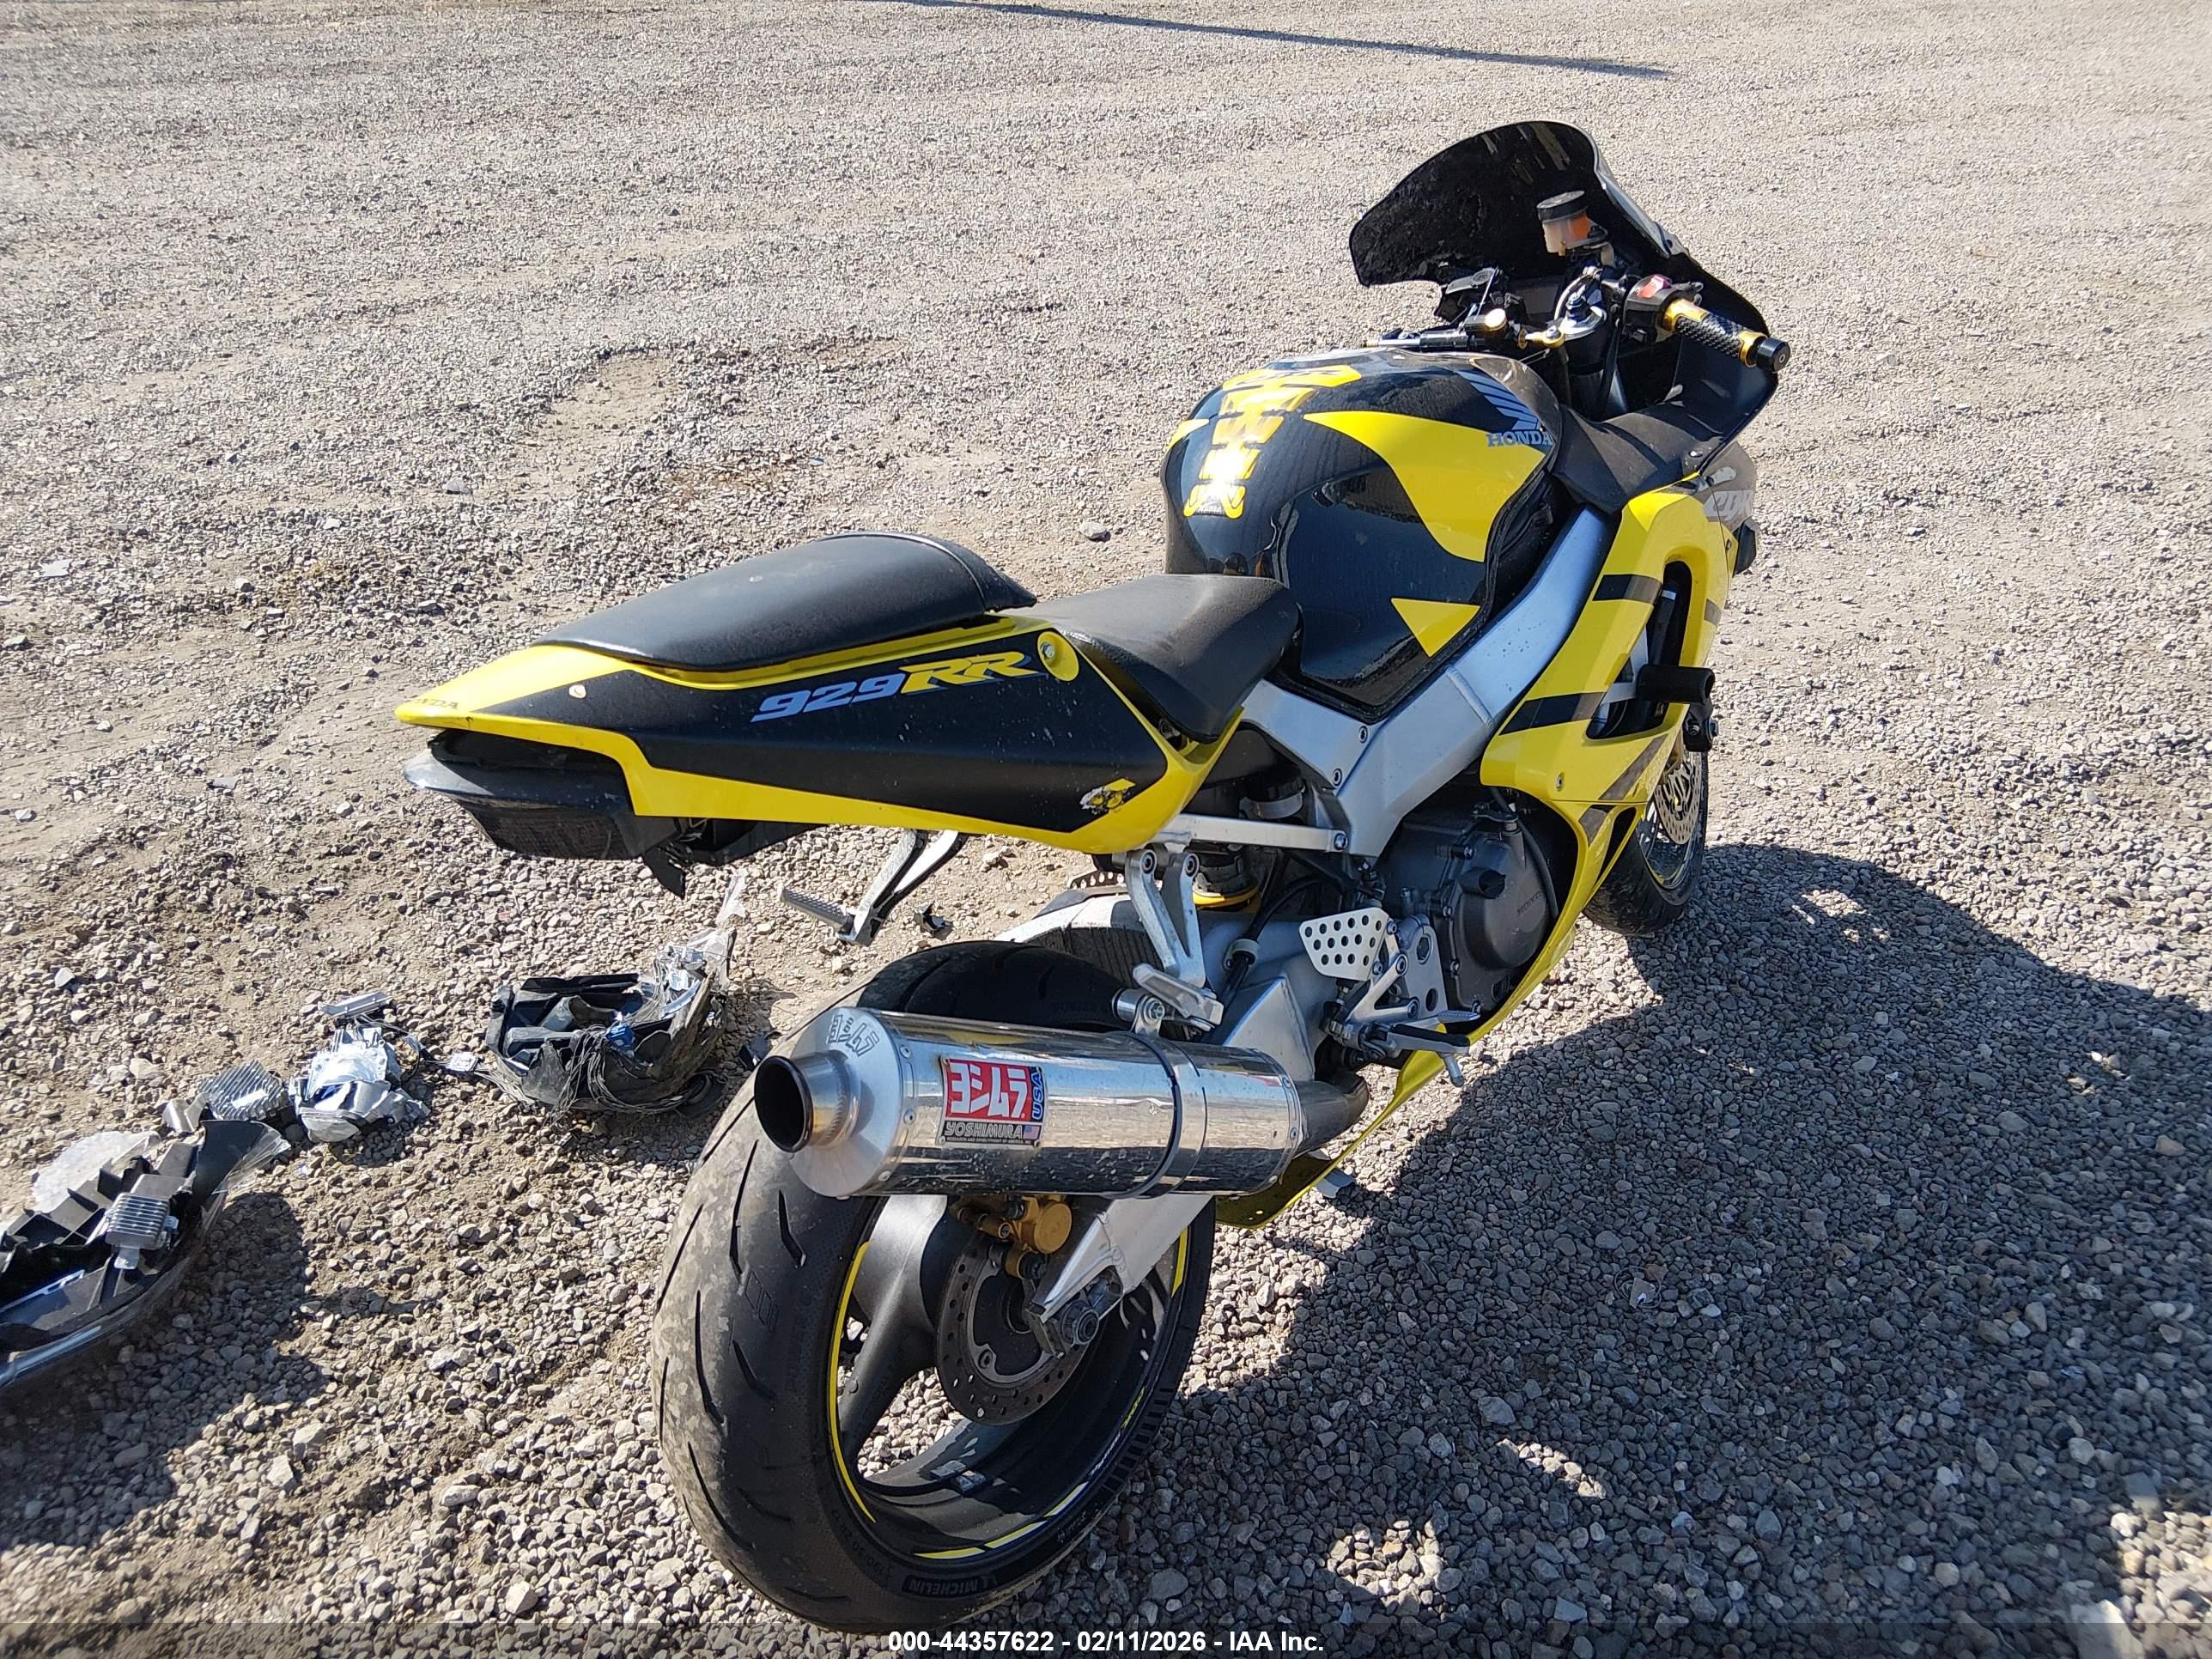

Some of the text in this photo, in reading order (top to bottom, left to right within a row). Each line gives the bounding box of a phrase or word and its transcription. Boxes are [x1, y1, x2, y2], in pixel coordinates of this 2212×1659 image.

[1486, 430, 1553, 448] HONDA
[750, 651, 1048, 723] 929RR
[1516, 890, 1542, 917] HOND
[1030, 1070, 1045, 1121] USA
[945, 1121, 1023, 1139] YOSHIMURA
[908, 1577, 979, 1595] MICHELIN
